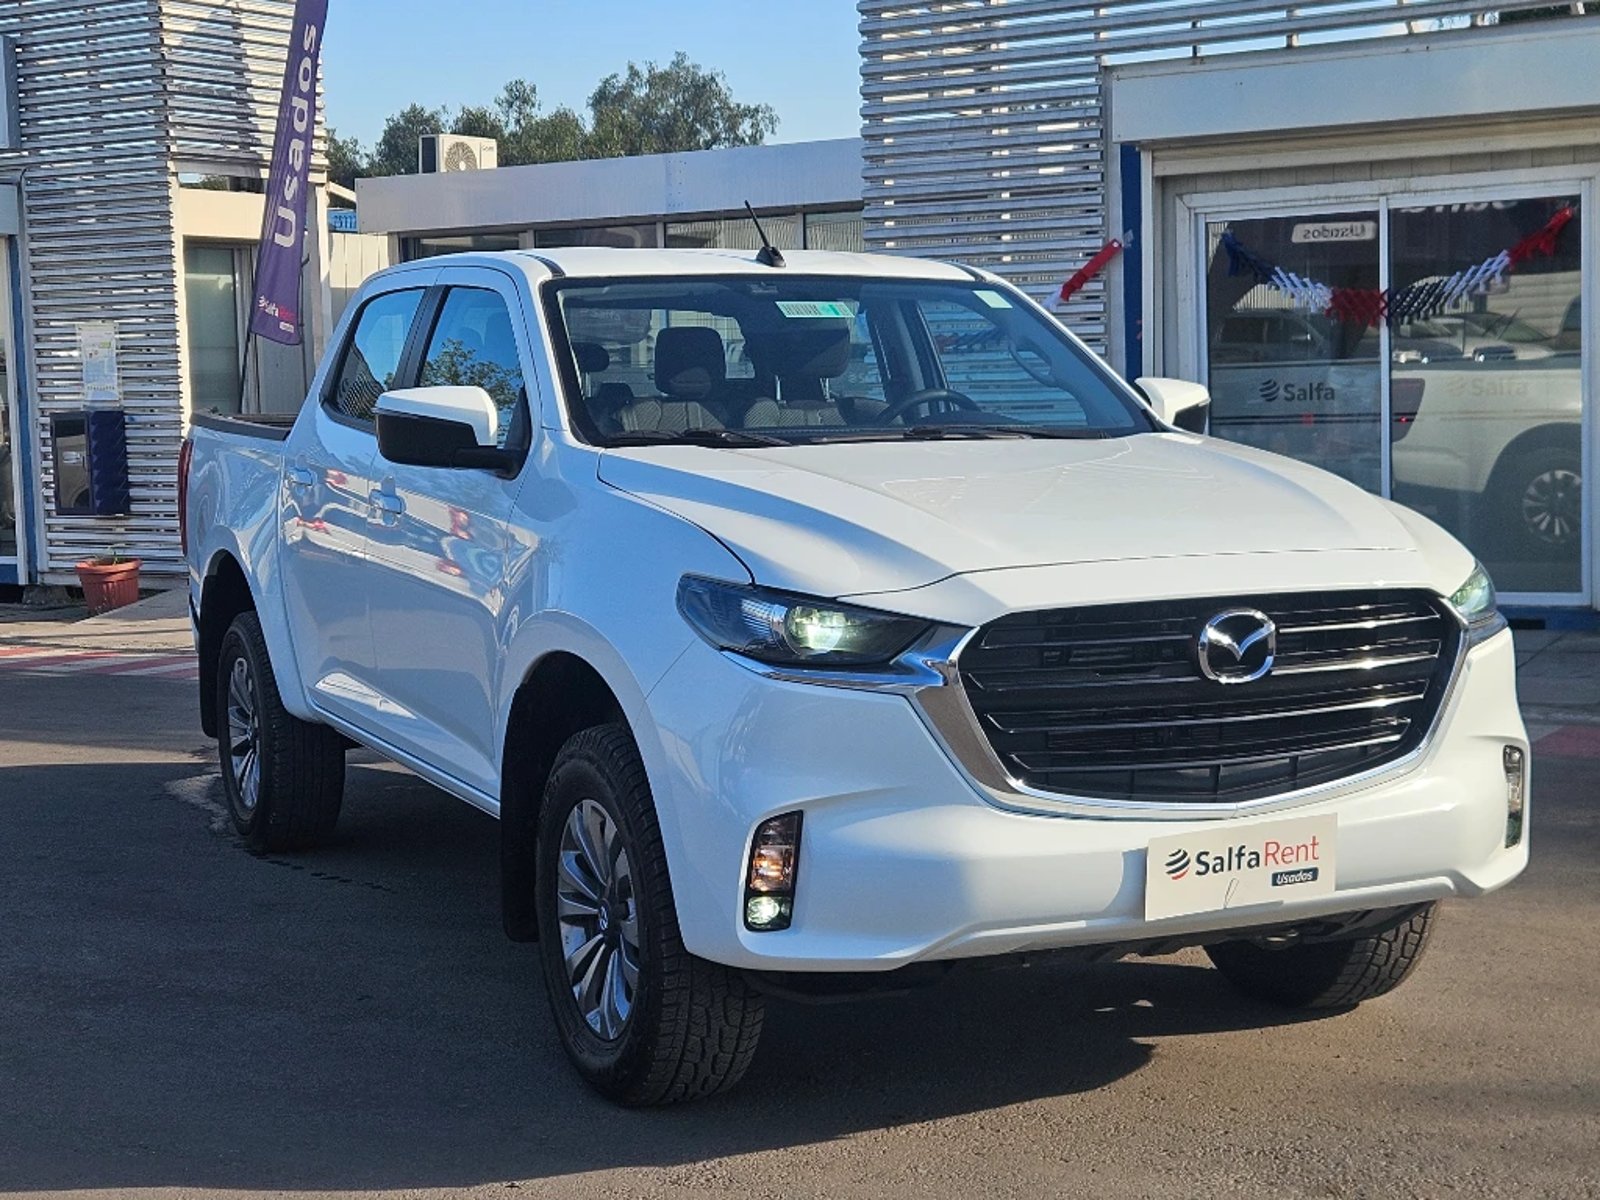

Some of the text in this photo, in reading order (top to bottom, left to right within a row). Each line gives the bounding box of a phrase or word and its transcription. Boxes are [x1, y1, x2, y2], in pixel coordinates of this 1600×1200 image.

[274, 23, 317, 248] Usados
[1283, 382, 1336, 402] Salfa
[1471, 376, 1529, 397] Salfa
[1276, 868, 1313, 885] Usados
